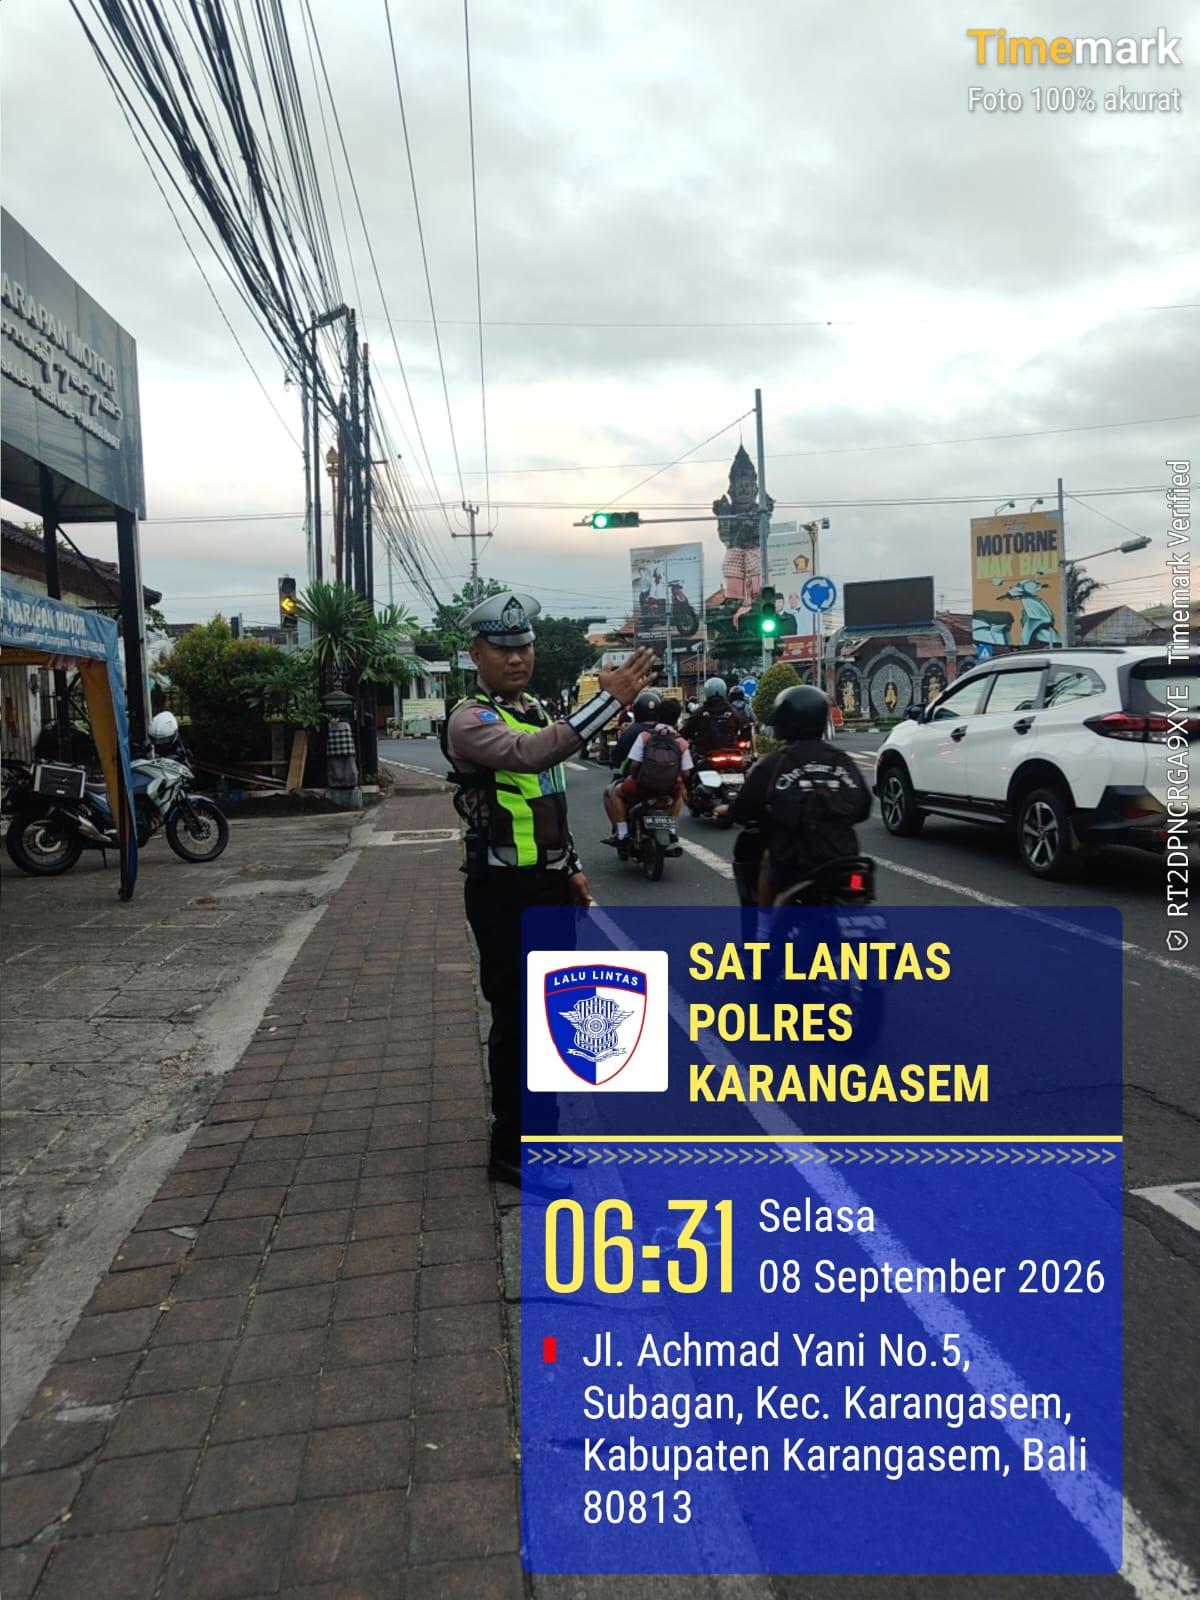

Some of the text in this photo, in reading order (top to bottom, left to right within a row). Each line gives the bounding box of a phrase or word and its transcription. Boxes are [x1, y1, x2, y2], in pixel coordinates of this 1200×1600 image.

[70, 331, 118, 392] MOTOR
[976, 529, 1058, 557] MOTORNE
[976, 554, 1014, 578] NAK
[7, 599, 56, 630] HARAPAN
[55, 610, 86, 636] MOTOR
